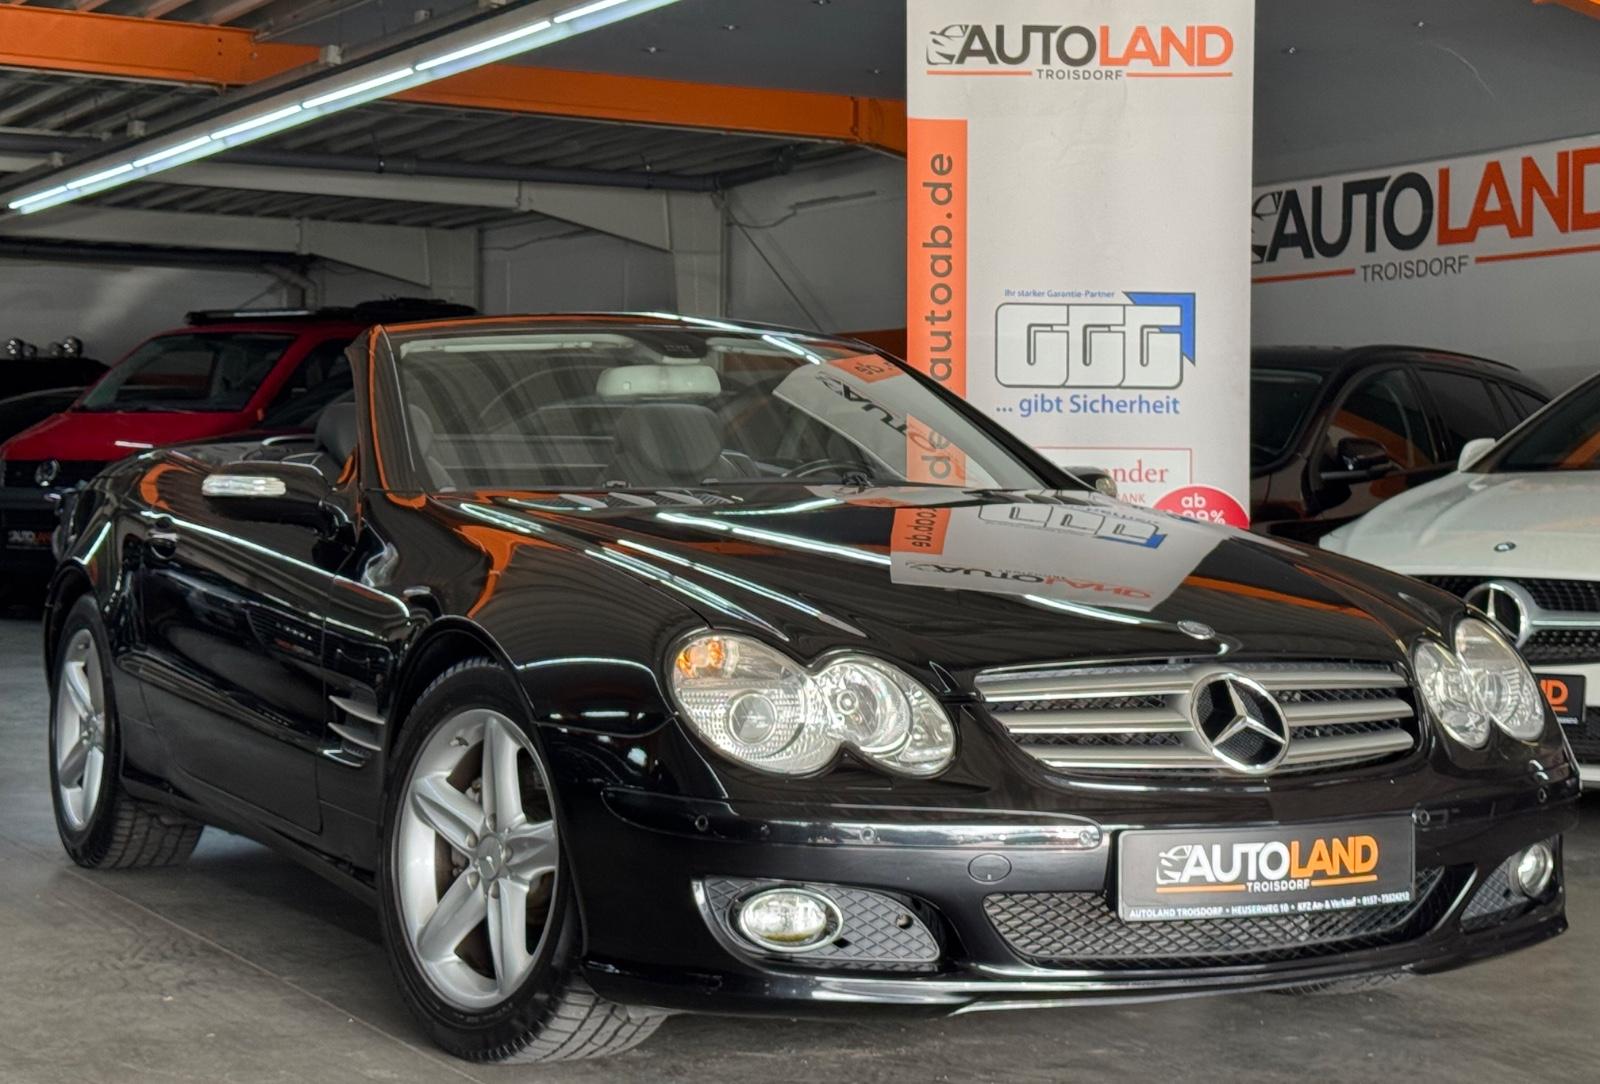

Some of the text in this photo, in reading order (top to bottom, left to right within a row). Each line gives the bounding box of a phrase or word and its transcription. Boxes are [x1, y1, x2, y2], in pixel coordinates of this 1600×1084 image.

[956, 24, 1234, 67] AUTOLAND
[1036, 69, 1123, 81] TROISDORF
[1360, 255, 1469, 283] TROISDORF
[1004, 289, 1115, 299] Ihr starker Garantie-Partner
[1019, 394, 1063, 417] gibt
[1069, 394, 1180, 414] Sicherheit
[1181, 493, 1206, 508] ab
[1179, 835, 1379, 883] AUTOLAND
[1246, 879, 1311, 893] TROISDORF
[1129, 908, 1175, 918] AUTOLAND
[1177, 906, 1222, 917] TROISDORF
[1231, 903, 1279, 915] HEUSERWEG
